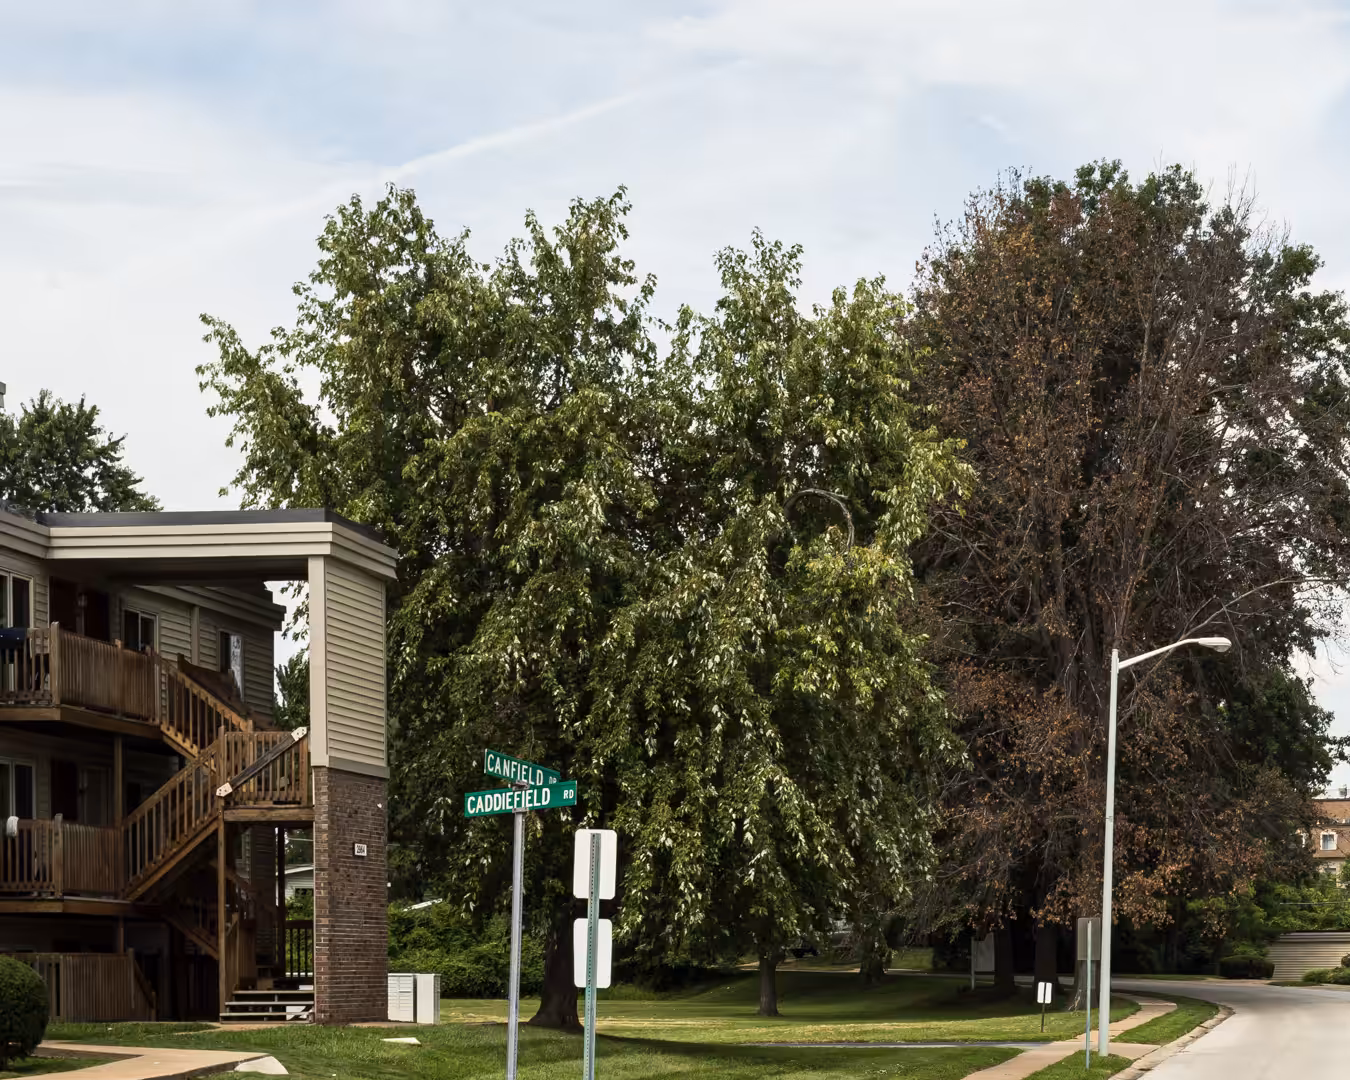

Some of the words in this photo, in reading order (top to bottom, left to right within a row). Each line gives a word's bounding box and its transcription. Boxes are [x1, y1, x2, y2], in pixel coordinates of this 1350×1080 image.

[487, 754, 544, 786] CANFIELD
[467, 787, 551, 814] CADDIEFIELD
[563, 789, 574, 799] RD
